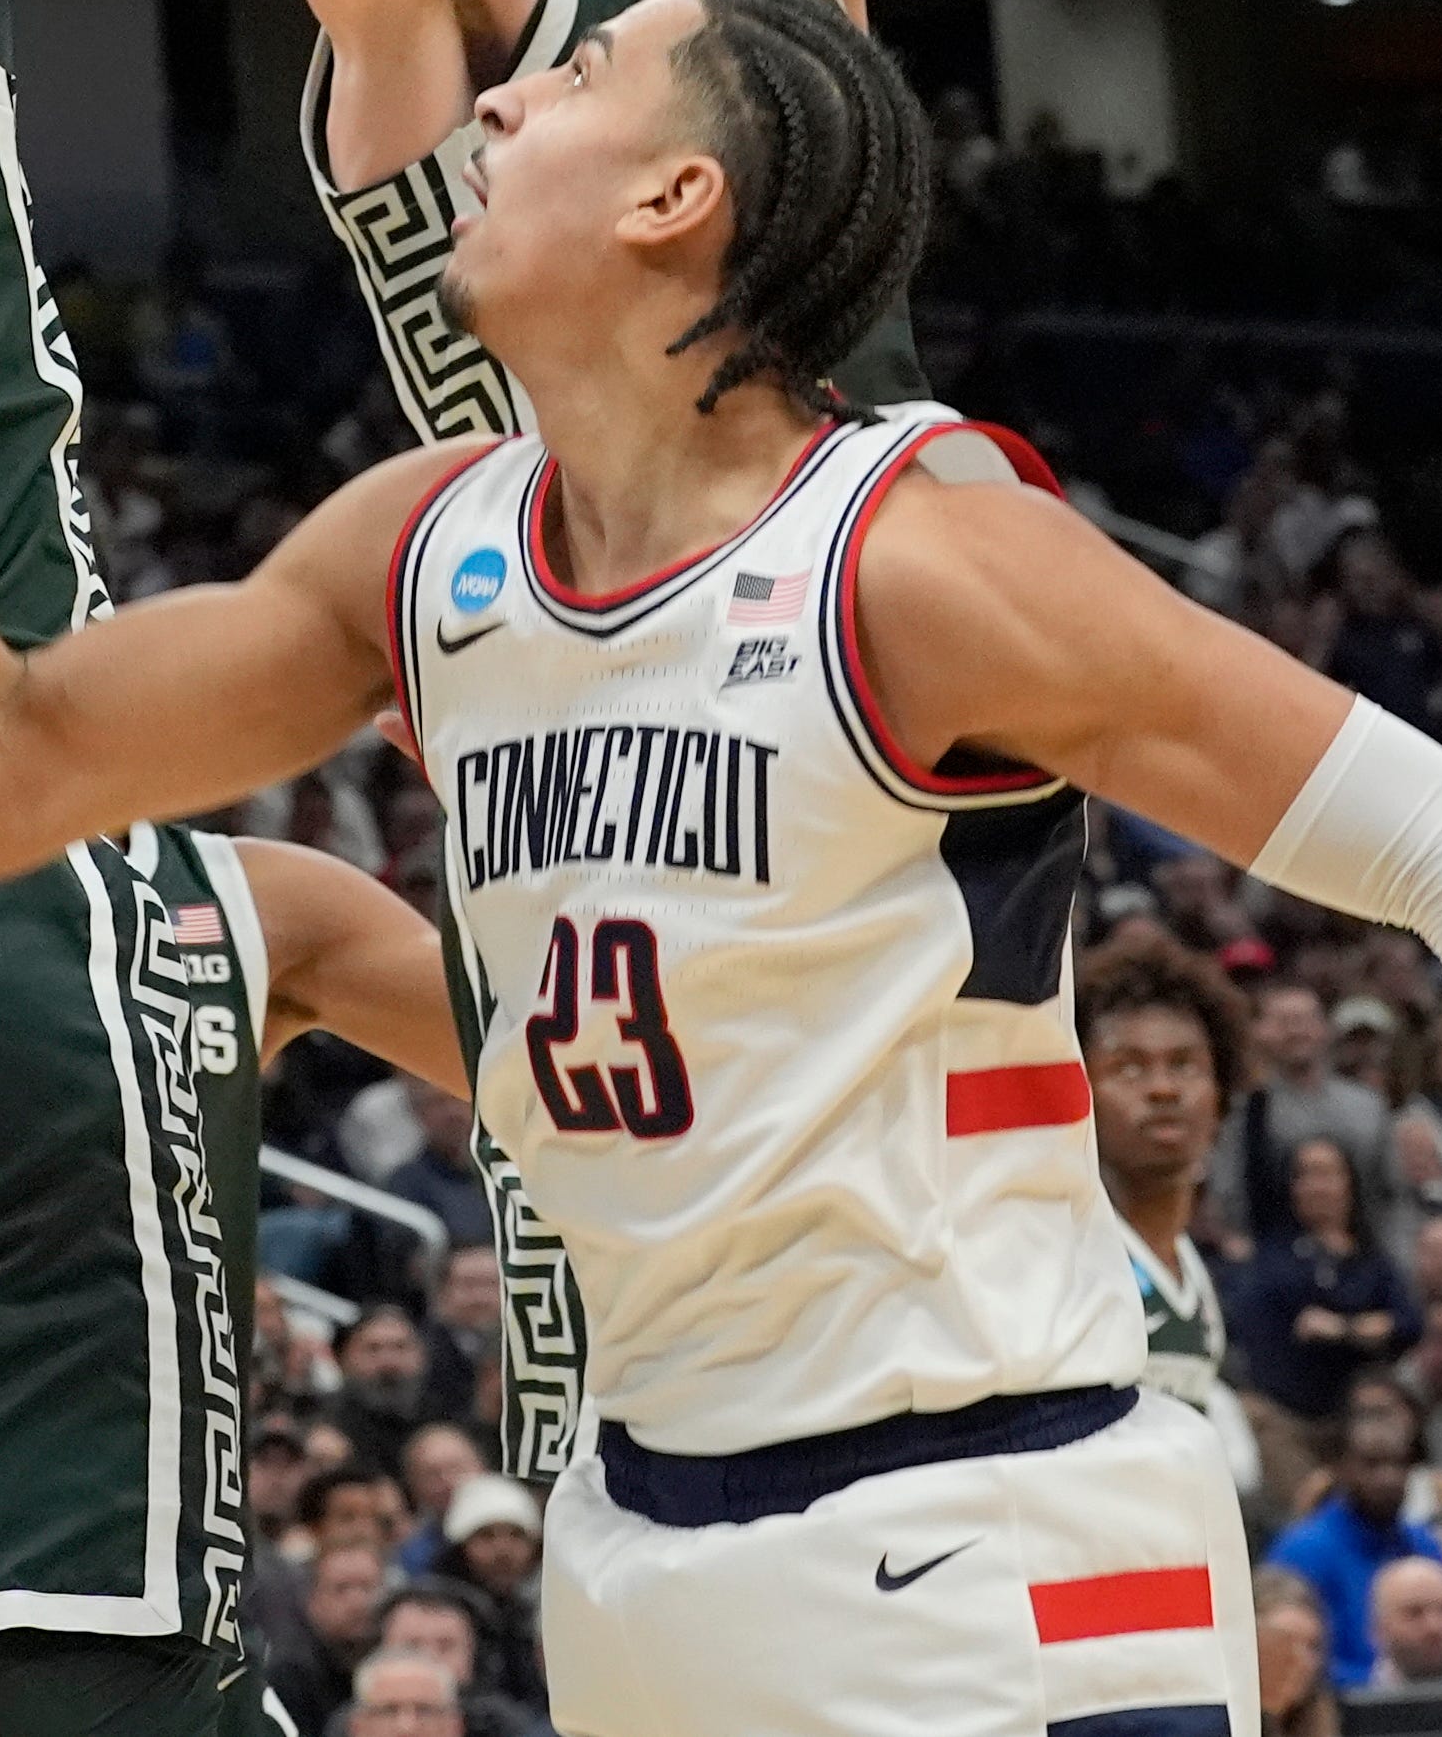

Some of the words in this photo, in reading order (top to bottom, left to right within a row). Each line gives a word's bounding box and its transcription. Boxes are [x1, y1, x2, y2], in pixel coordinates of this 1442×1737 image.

[726, 655, 802, 683] EAST
[734, 637, 789, 662] BIG
[457, 723, 779, 893] CONNECTICUT
[525, 915, 695, 1140] 23
